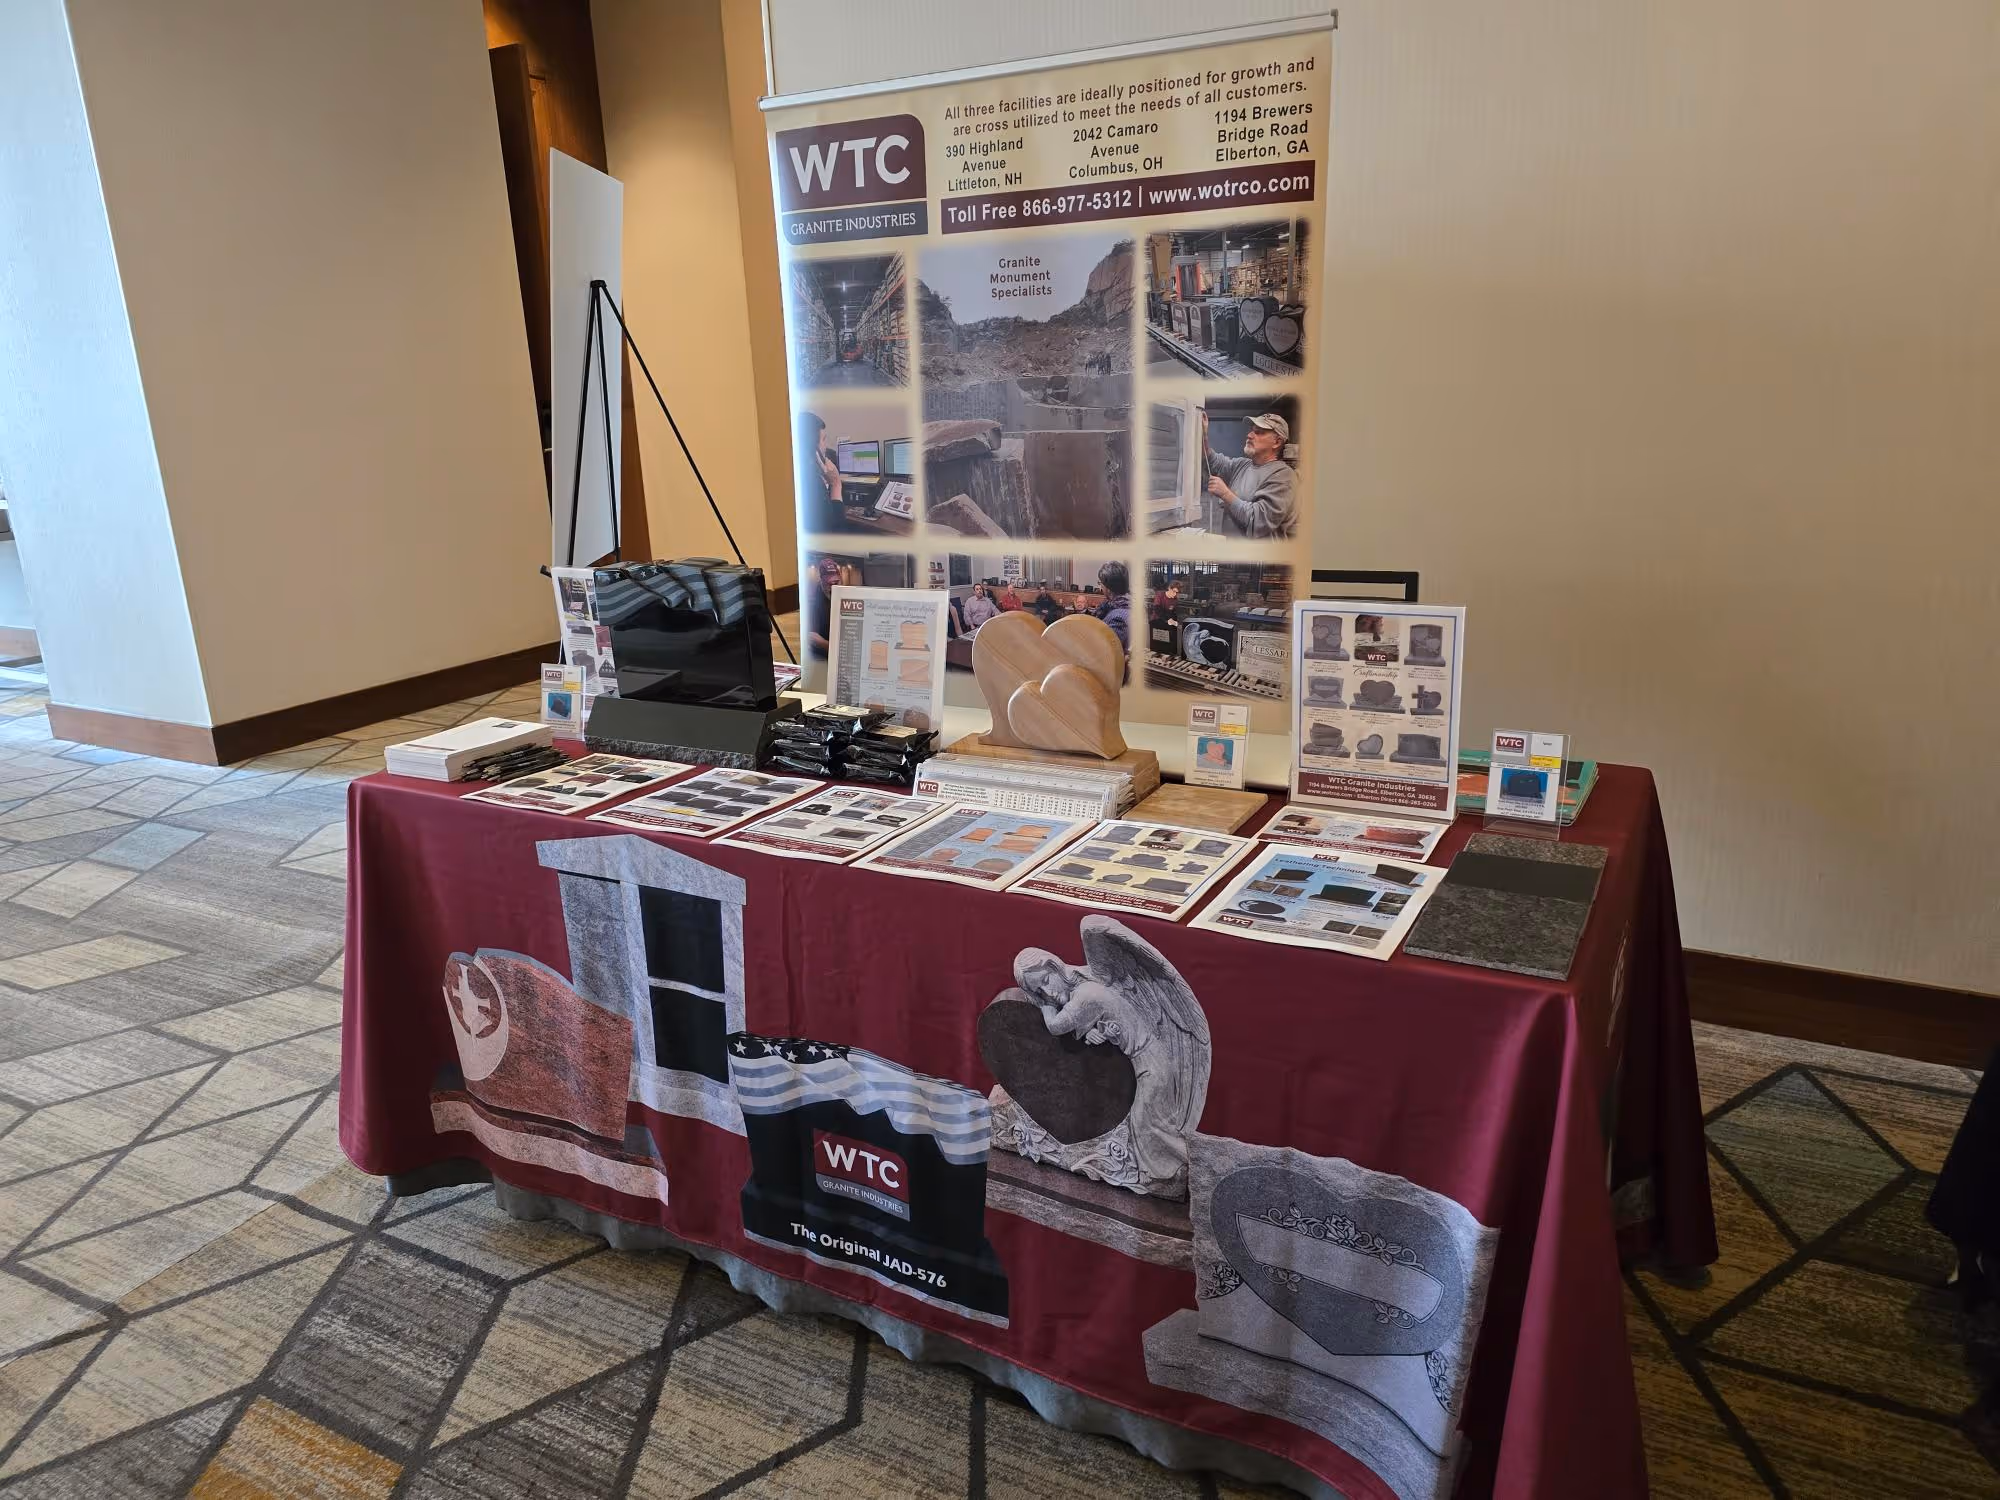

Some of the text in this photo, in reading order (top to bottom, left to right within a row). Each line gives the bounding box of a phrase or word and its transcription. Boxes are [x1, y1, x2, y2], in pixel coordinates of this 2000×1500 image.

[944, 57, 1315, 120] All three facilities are ideally positioned for growth and
[953, 81, 1307, 136] are cross utilized to meet the needs of all customers.
[1214, 103, 1313, 125] 1194 Brewers
[1073, 123, 1158, 142] 2042 Camaro
[1218, 120, 1308, 143] Bridge Road
[946, 137, 1023, 158] 390 Highland
[1090, 143, 1139, 158] Avenue
[1216, 139, 1310, 162] Elberton, GA
[789, 134, 911, 194] WTC
[962, 160, 1006, 173] Avenue
[1069, 156, 1163, 179] Columbus, OH
[948, 172, 1022, 192] Littleton, NH
[948, 205, 976, 224] Toll
[982, 204, 1017, 221] Free
[1022, 190, 1132, 217] 866-977-5312
[1149, 175, 1310, 205] www.wotrco.com
[791, 213, 917, 236] GRANITE INDUSTRIES
[999, 256, 1040, 268] Granite
[990, 270, 1051, 284] Monument
[991, 285, 1052, 300] Specialists
[843, 601, 863, 610] WTC
[1195, 710, 1214, 718] WTC
[1500, 738, 1522, 747] WTC
[920, 783, 937, 791] WTC
[1328, 776, 1416, 792] WTC Granite Industries
[1380, 790, 1406, 798] Elberton,
[1321, 865, 1366, 874] Technique
[1222, 916, 1251, 925] WTC
[823, 1140, 900, 1189] WTC
[823, 1180, 903, 1213] GRANITE INDUSTRIES
[791, 1223, 948, 1288] The Original JAD-576
